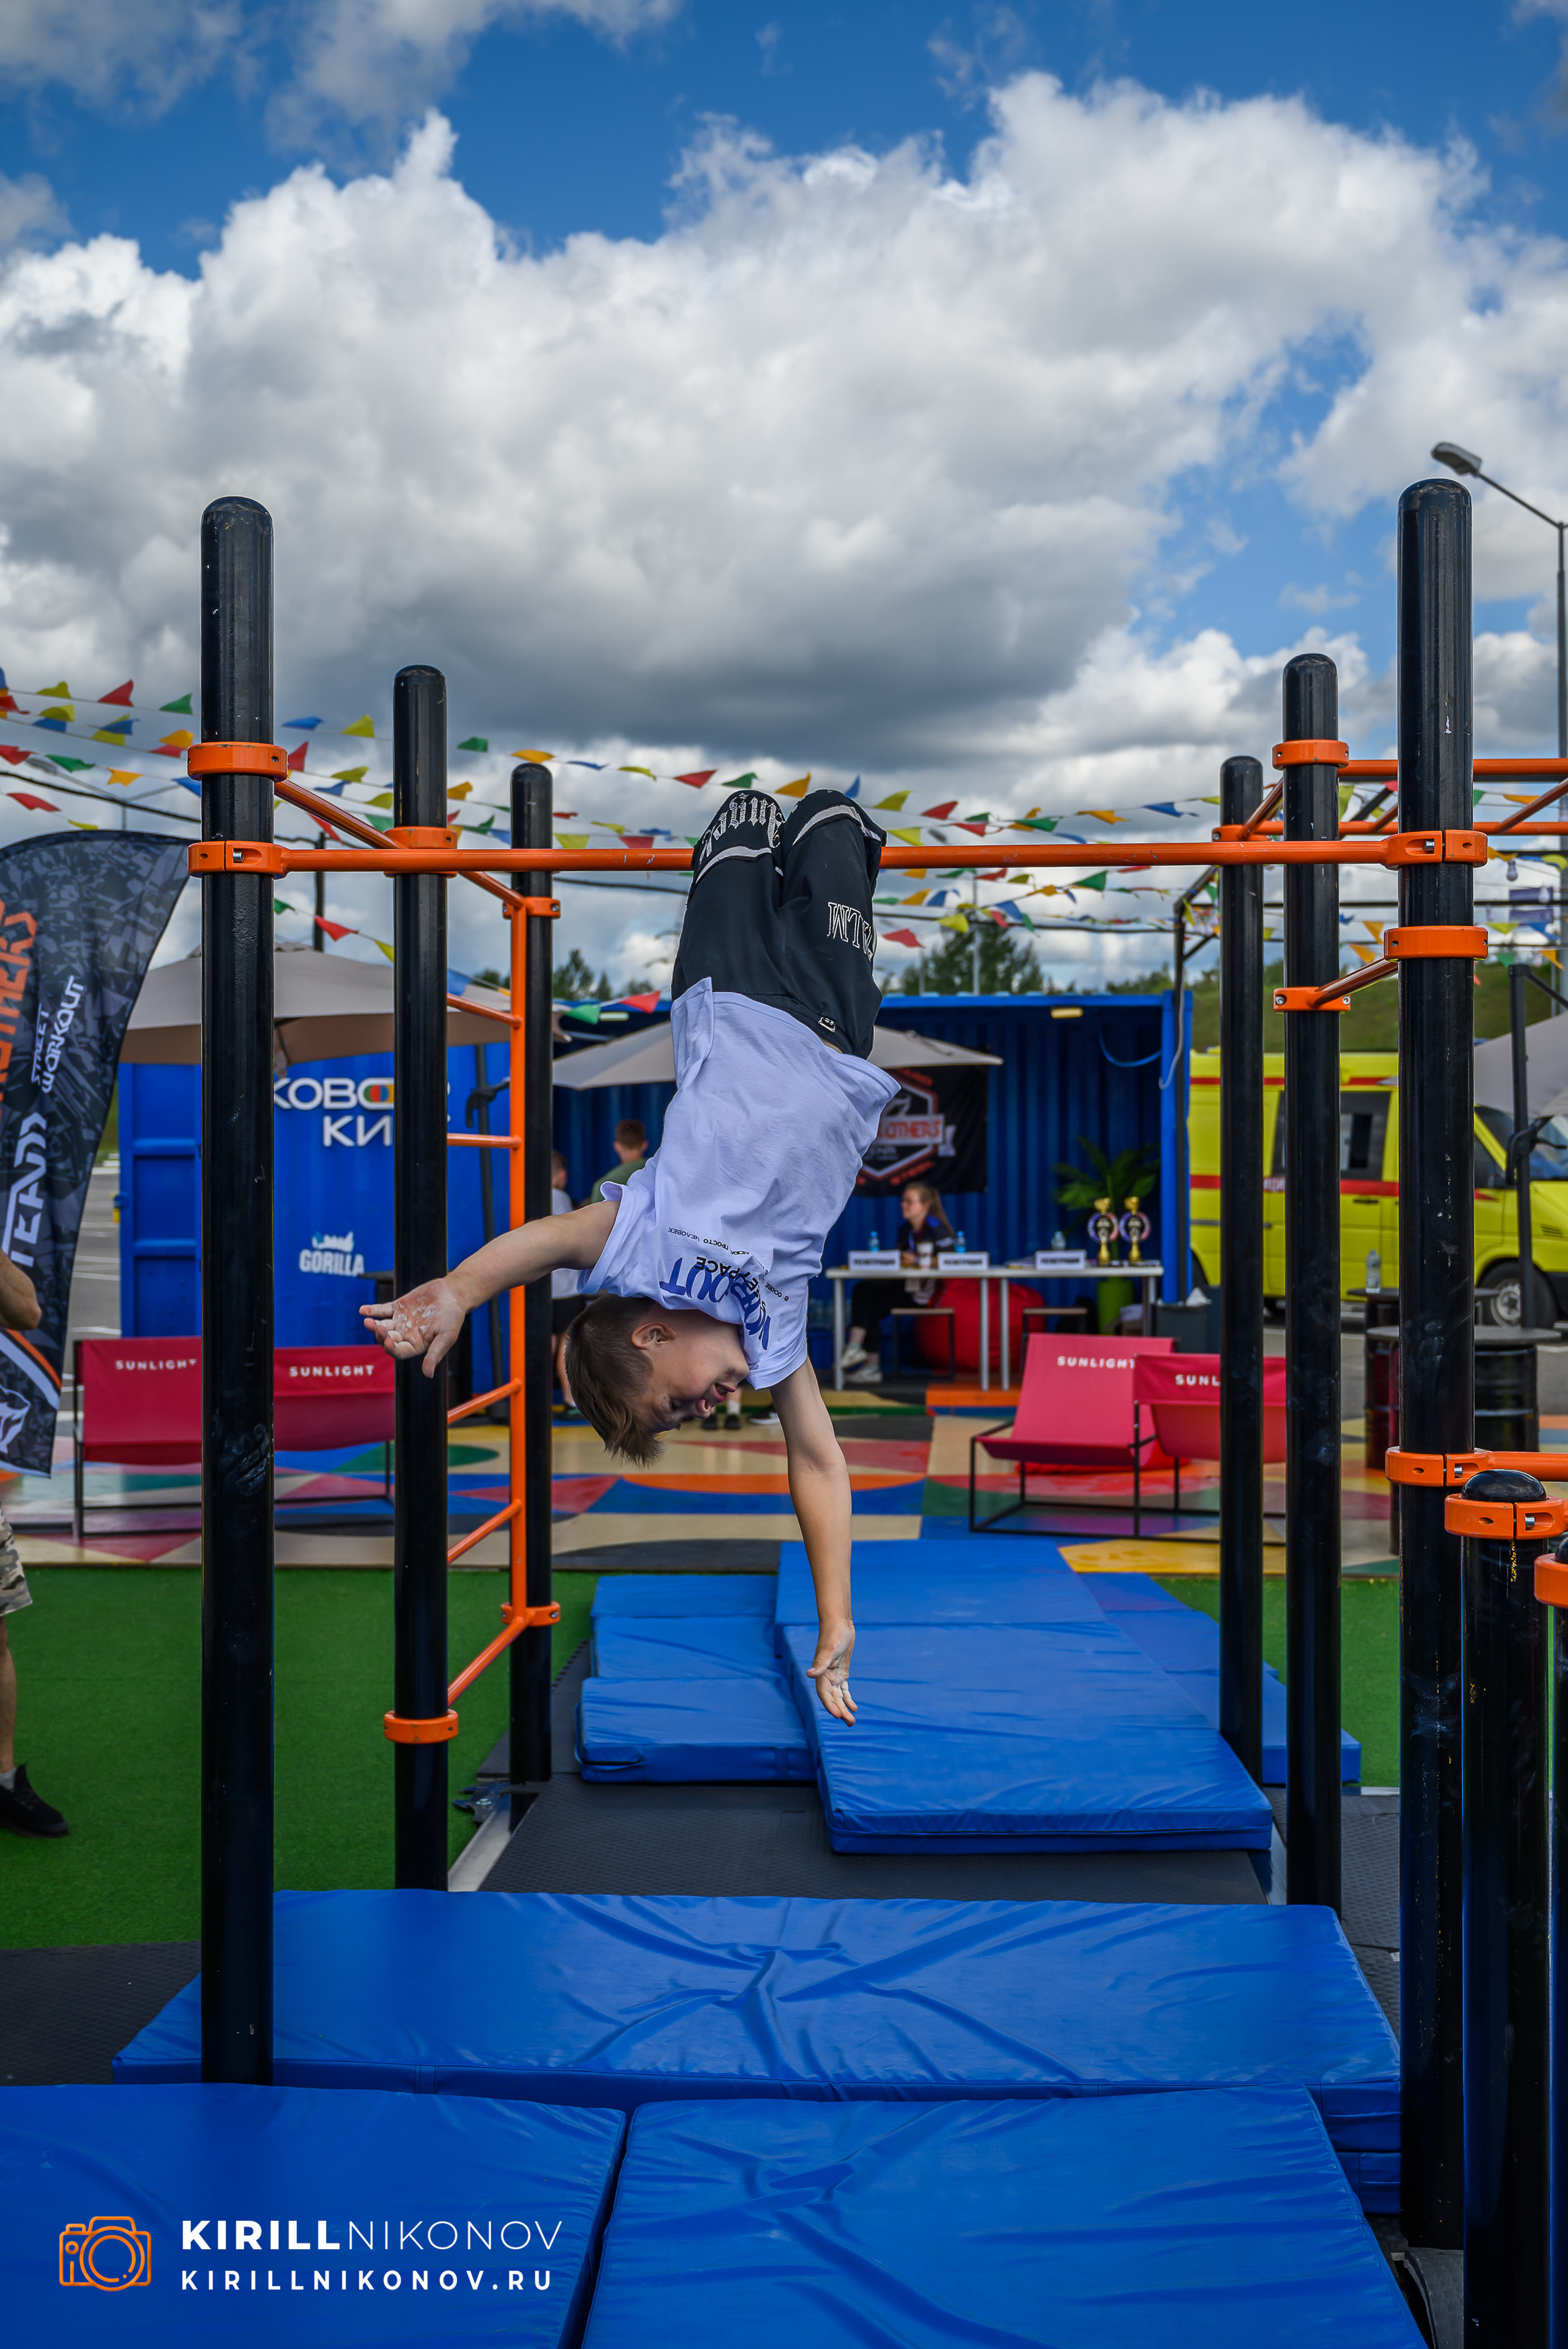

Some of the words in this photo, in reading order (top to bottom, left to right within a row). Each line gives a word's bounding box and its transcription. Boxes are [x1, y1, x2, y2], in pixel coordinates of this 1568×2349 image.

[827, 901, 874, 962] ALM
[42, 974, 85, 1094] WORKOUT
[878, 1120, 941, 1139] OTHERS
[668, 1227, 700, 1242] ЧЕЛОВЕК
[703, 1238, 729, 1250] ПРОСТО
[299, 1249, 366, 1277] GORILLA
[115, 1358, 197, 1370] SUNLIGHT
[1057, 1355, 1135, 1369] SUNLIGHT
[289, 1365, 374, 1377] SUNLIGHT
